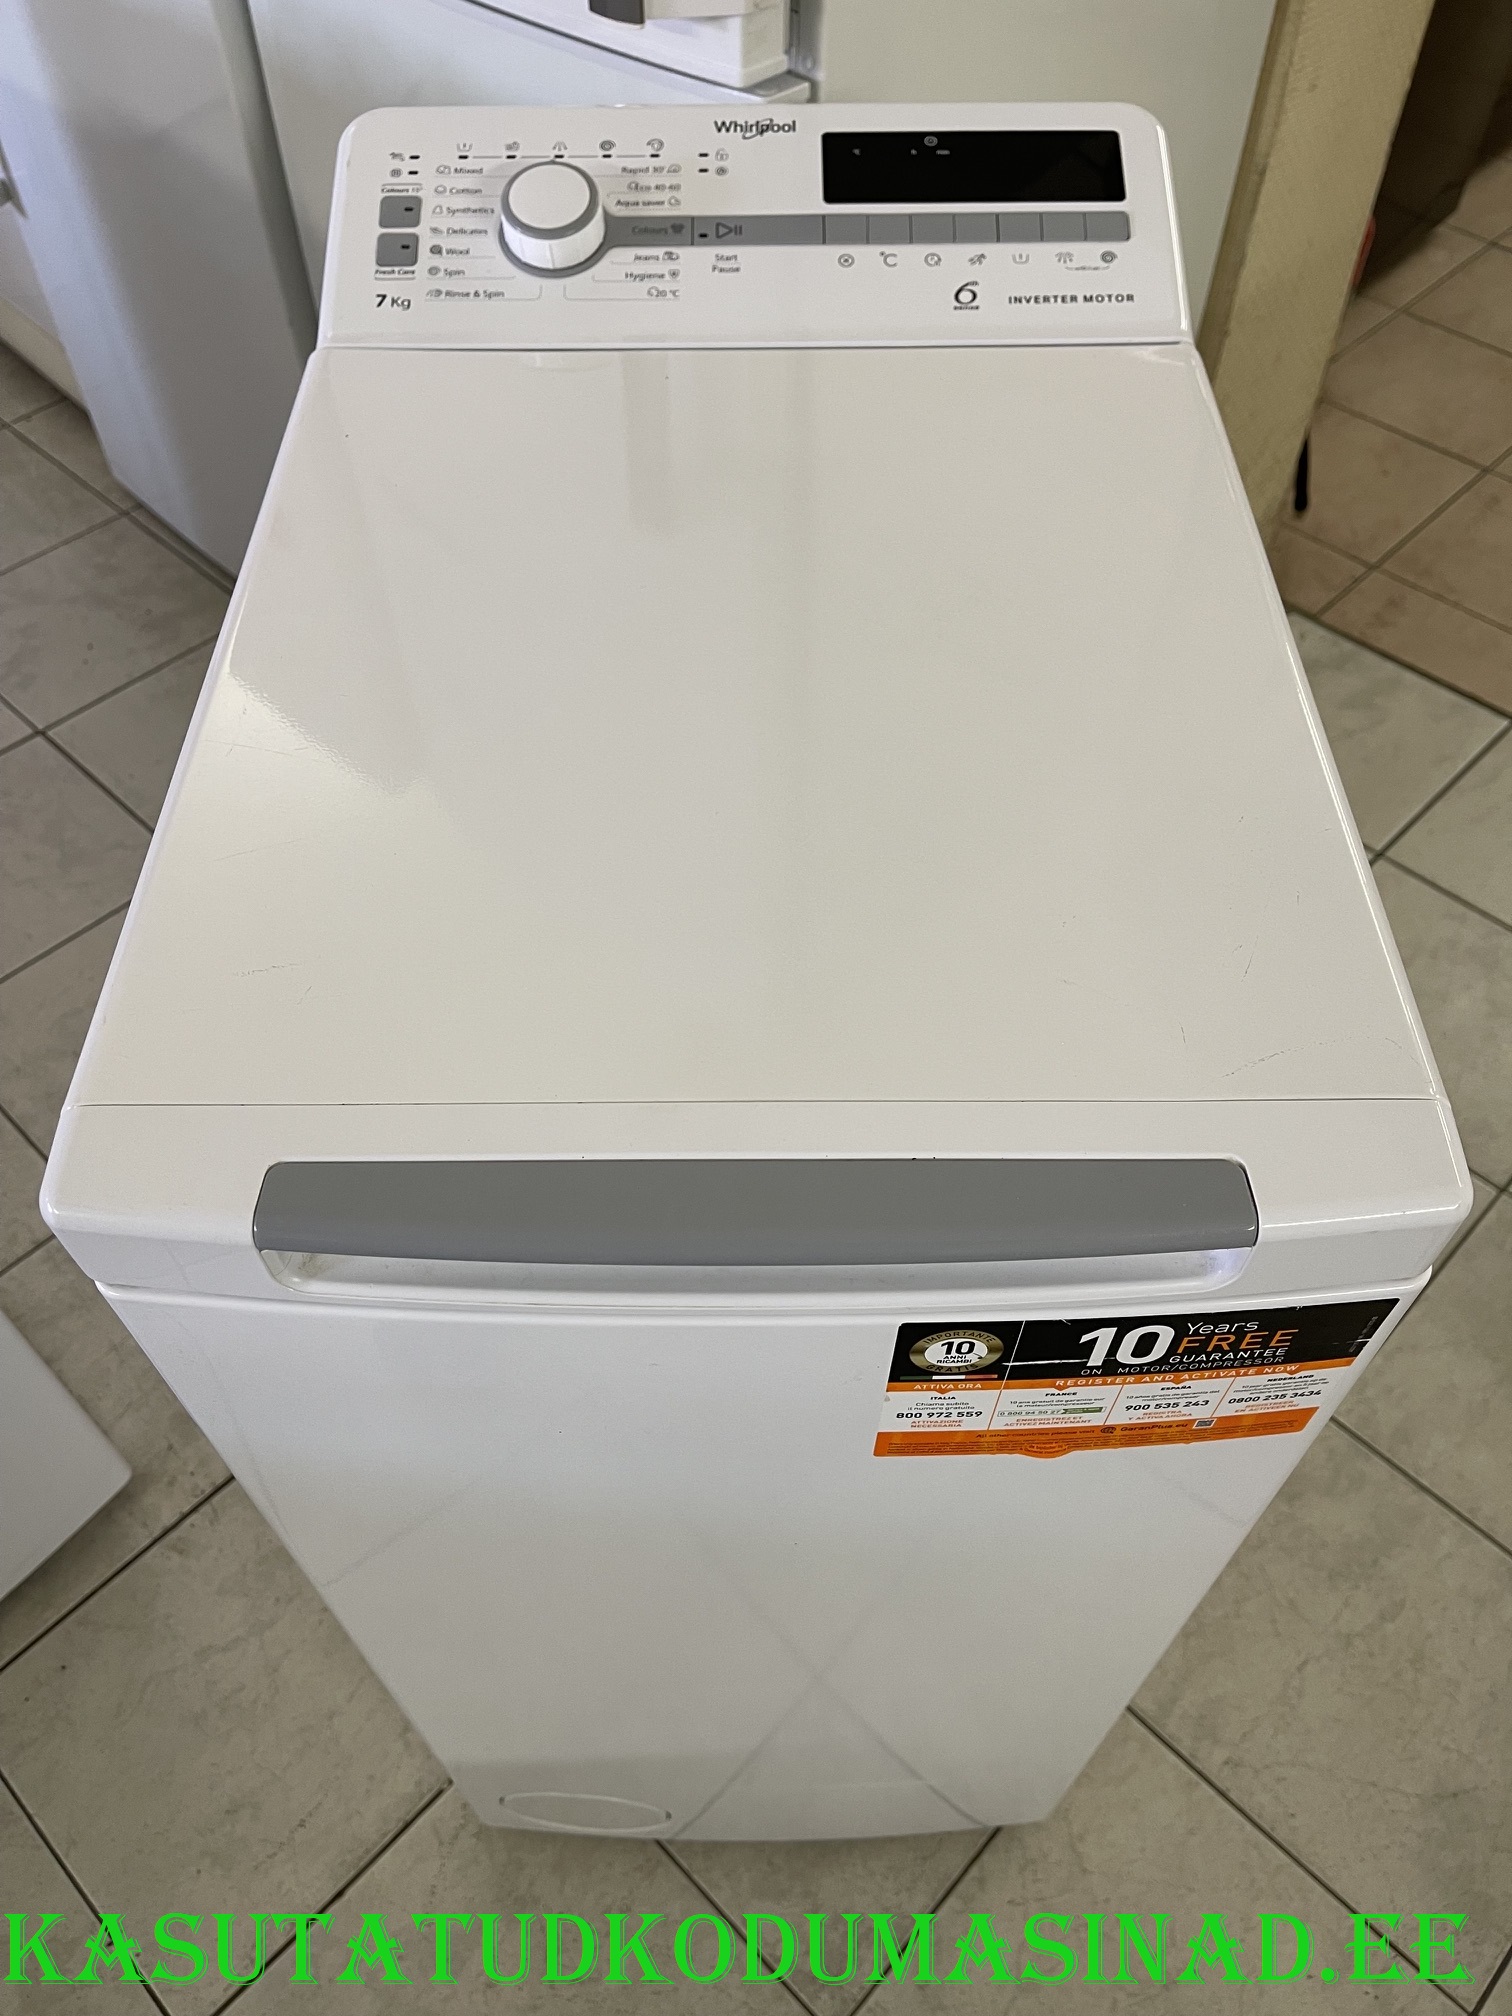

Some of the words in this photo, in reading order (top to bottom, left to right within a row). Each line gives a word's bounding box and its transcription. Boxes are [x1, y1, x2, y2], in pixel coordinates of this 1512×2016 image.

[714, 119, 796, 139] Whirlpool
[453, 167, 484, 175] Mixed
[448, 186, 483, 195] Cotton
[615, 199, 640, 208] Aqua
[446, 206, 495, 216] Synthetics
[446, 227, 489, 236] Delicates
[631, 226, 669, 235] Colours
[445, 247, 470, 256] Wool
[634, 253, 660, 262] Jeans
[714, 253, 738, 262] Start
[443, 268, 465, 277] Spin
[711, 264, 741, 274] Pause
[625, 271, 666, 282] Hygiene
[444, 289, 471, 298] Rinse
[473, 289, 481, 298] &
[483, 289, 505, 299] Spin
[1008, 294, 1078, 305] INVERTER
[1082, 293, 1135, 304] MOTOR
[375, 293, 387, 308] 7
[390, 296, 412, 311] Kg
[1187, 1321, 1260, 1335] Years
[923, 1331, 996, 1344] IMPORTANTE
[1176, 1329, 1299, 1354] FREE
[941, 1341, 976, 1355] 10
[1078, 1325, 1175, 1367] 10
[1169, 1347, 1289, 1363] GUARANTEE
[926, 1364, 979, 1373] GRATIS
[1080, 1368, 1103, 1376] ON
[1117, 1356, 1285, 1374] MOTOR/COMPRESSOR
[1055, 1376, 1135, 1386] REGISTER
[1141, 1374, 1175, 1382] AND
[1181, 1368, 1257, 1380] ACTIVATE
[1261, 1364, 1300, 1373] NOW
[1266, 1374, 1315, 1382] NEDERLAND
[1228, 1396, 1261, 1404] 0800
[1262, 1393, 1287, 1401] 235
[1289, 1390, 1322, 1399] 3434
[926, 1411, 952, 1419] 972
